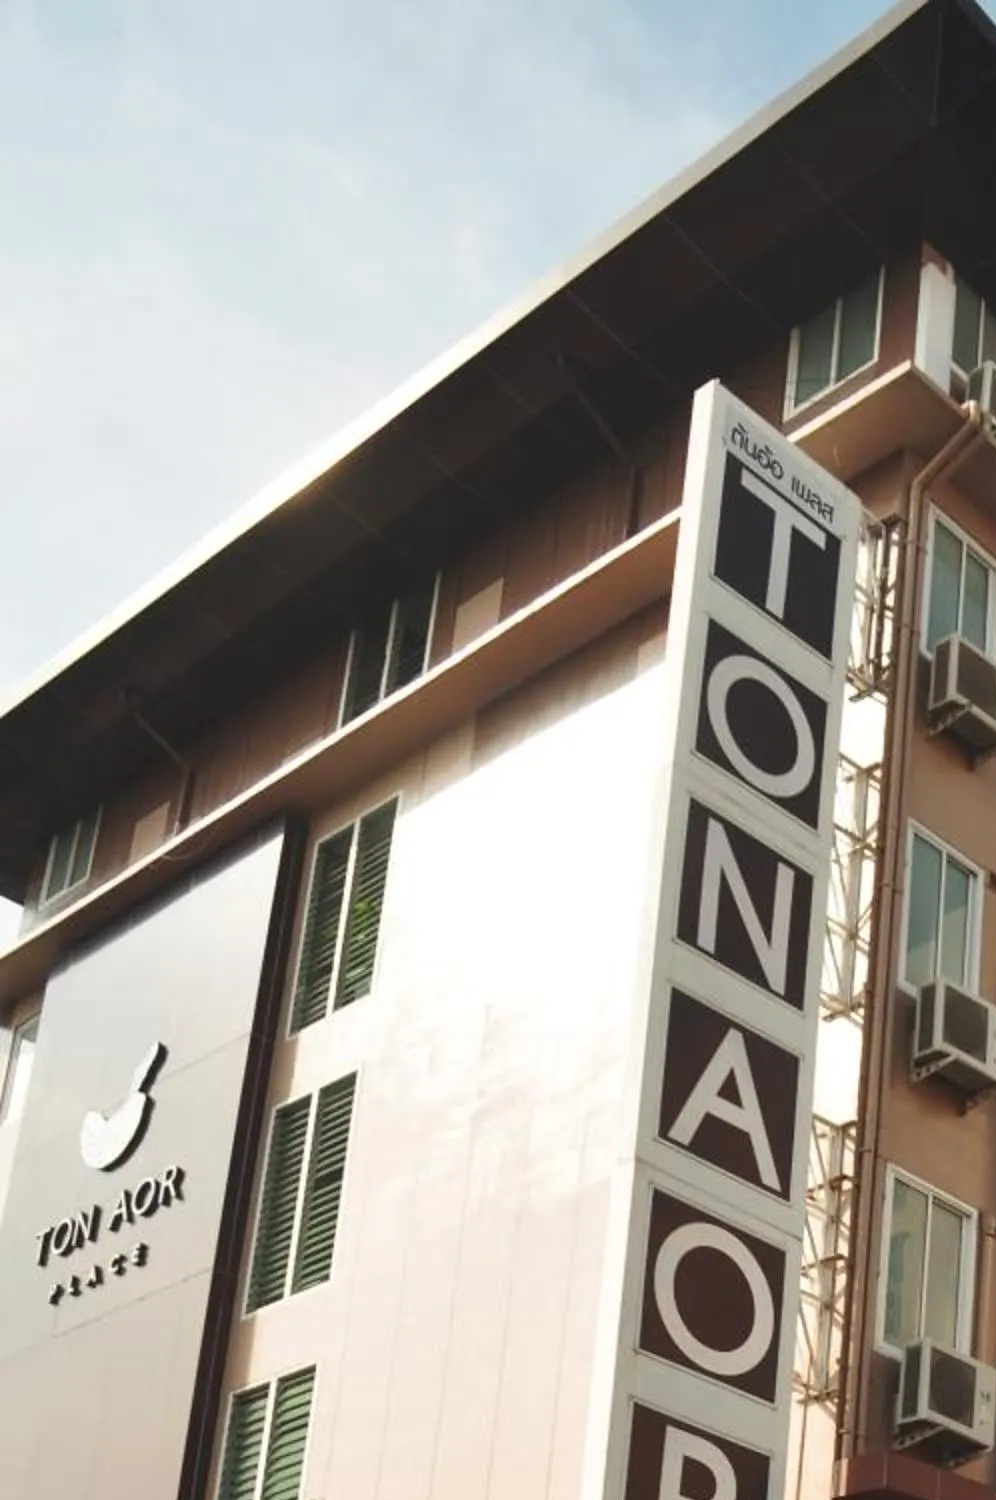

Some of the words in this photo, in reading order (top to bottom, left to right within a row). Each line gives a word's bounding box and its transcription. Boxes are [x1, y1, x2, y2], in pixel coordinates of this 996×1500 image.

[790, 476, 834, 524] เพลส
[36, 1204, 102, 1267] TON
[109, 1165, 186, 1233] AOR
